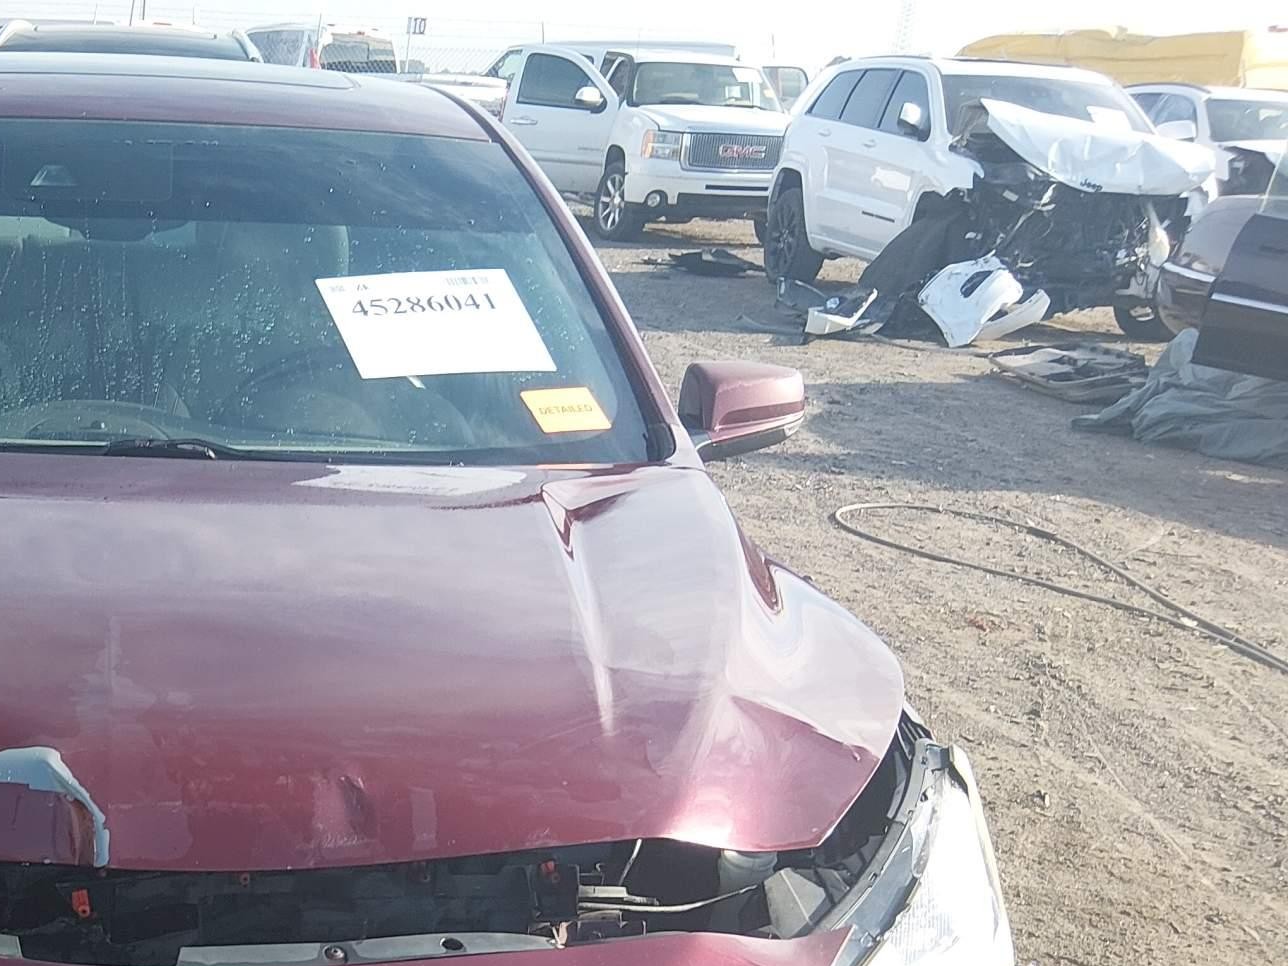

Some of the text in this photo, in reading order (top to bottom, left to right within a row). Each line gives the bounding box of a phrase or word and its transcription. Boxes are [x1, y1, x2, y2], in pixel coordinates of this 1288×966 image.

[719, 144, 767, 160] GMC
[1079, 178, 1104, 193] Jeep
[351, 292, 497, 317] 45286041
[538, 402, 594, 416] DETAILED
